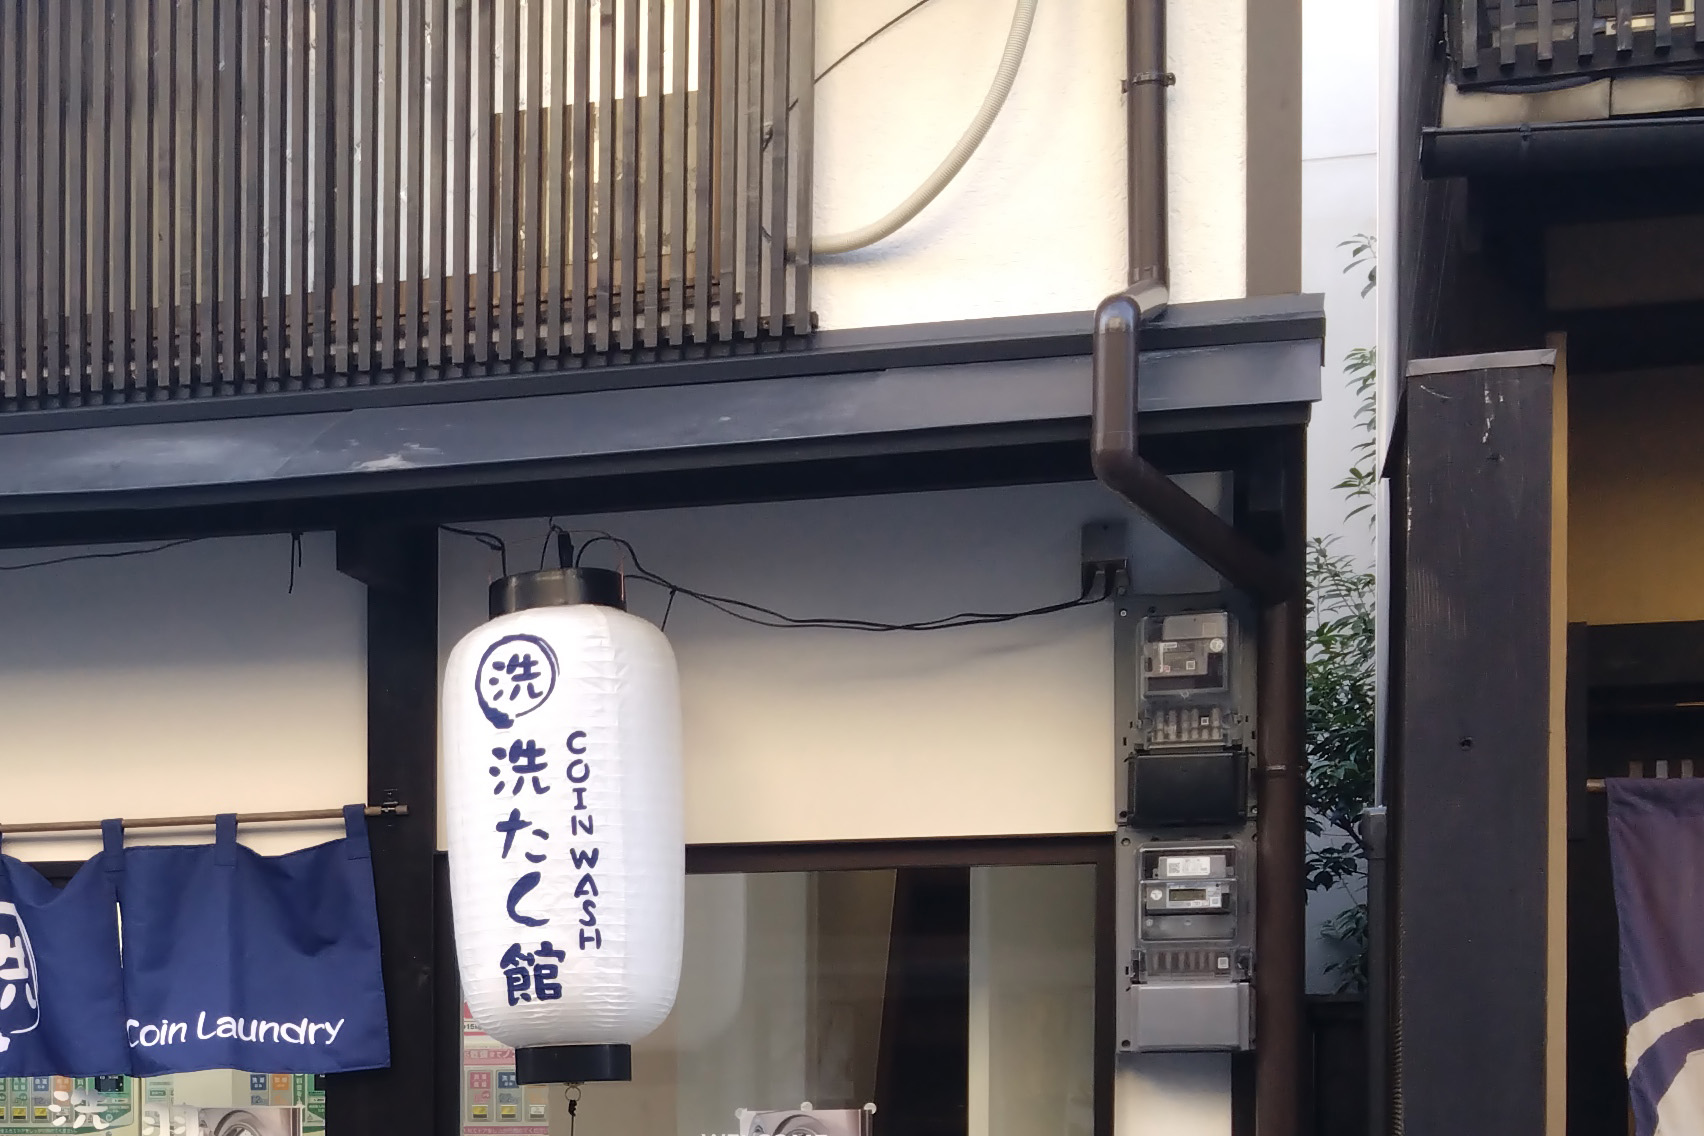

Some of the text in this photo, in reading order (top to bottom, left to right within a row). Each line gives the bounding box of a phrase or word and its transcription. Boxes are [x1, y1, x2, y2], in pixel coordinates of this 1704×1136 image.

[489, 653, 543, 701] 洗
[488, 739, 566, 1006] 洗たく館
[566, 730, 602, 950] COIN WASH
[126, 1011, 345, 1048] Coin Laundry
